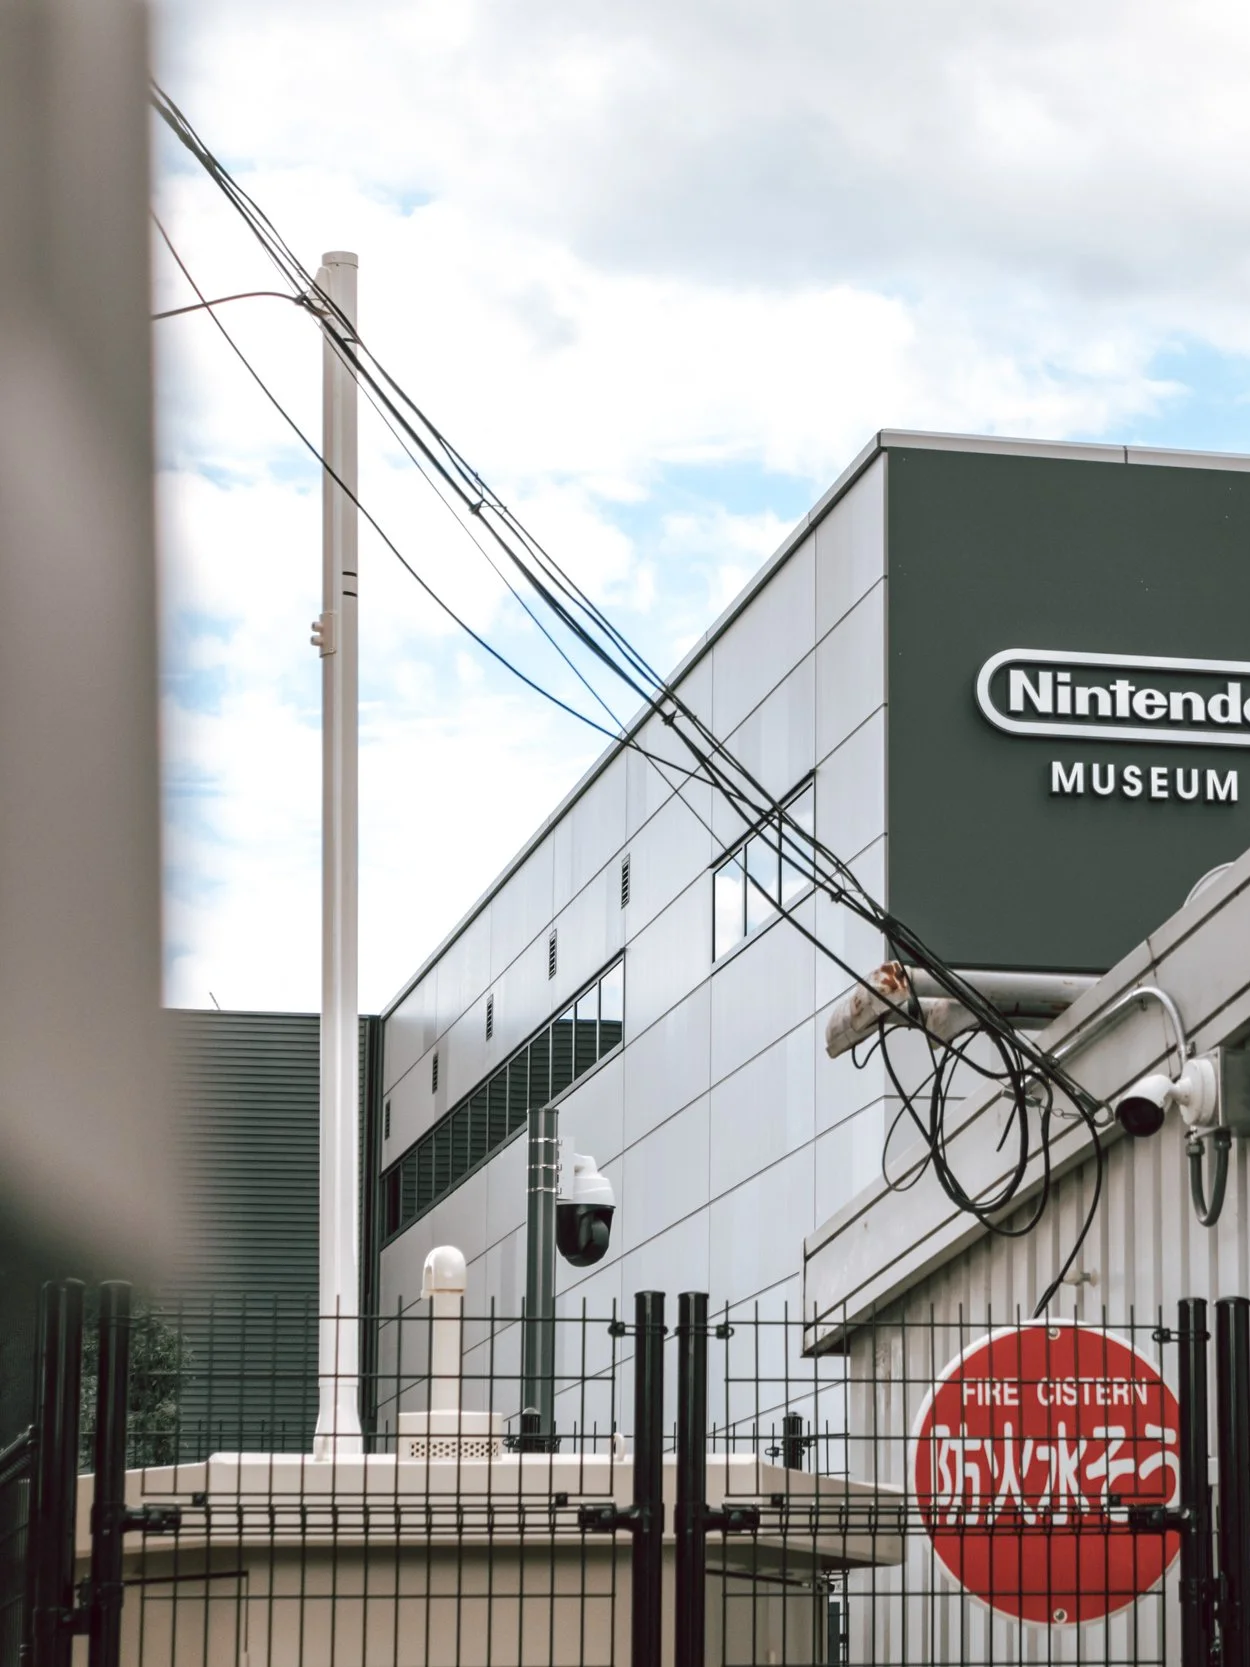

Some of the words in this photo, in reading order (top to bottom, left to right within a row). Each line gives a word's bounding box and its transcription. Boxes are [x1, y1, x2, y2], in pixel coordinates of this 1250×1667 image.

[1051, 760, 1239, 801] MUSEUM
[962, 1377, 1019, 1406] FIRE
[1036, 1376, 1148, 1407] CISTERN
[929, 1420, 1181, 1526] 防火水そう
